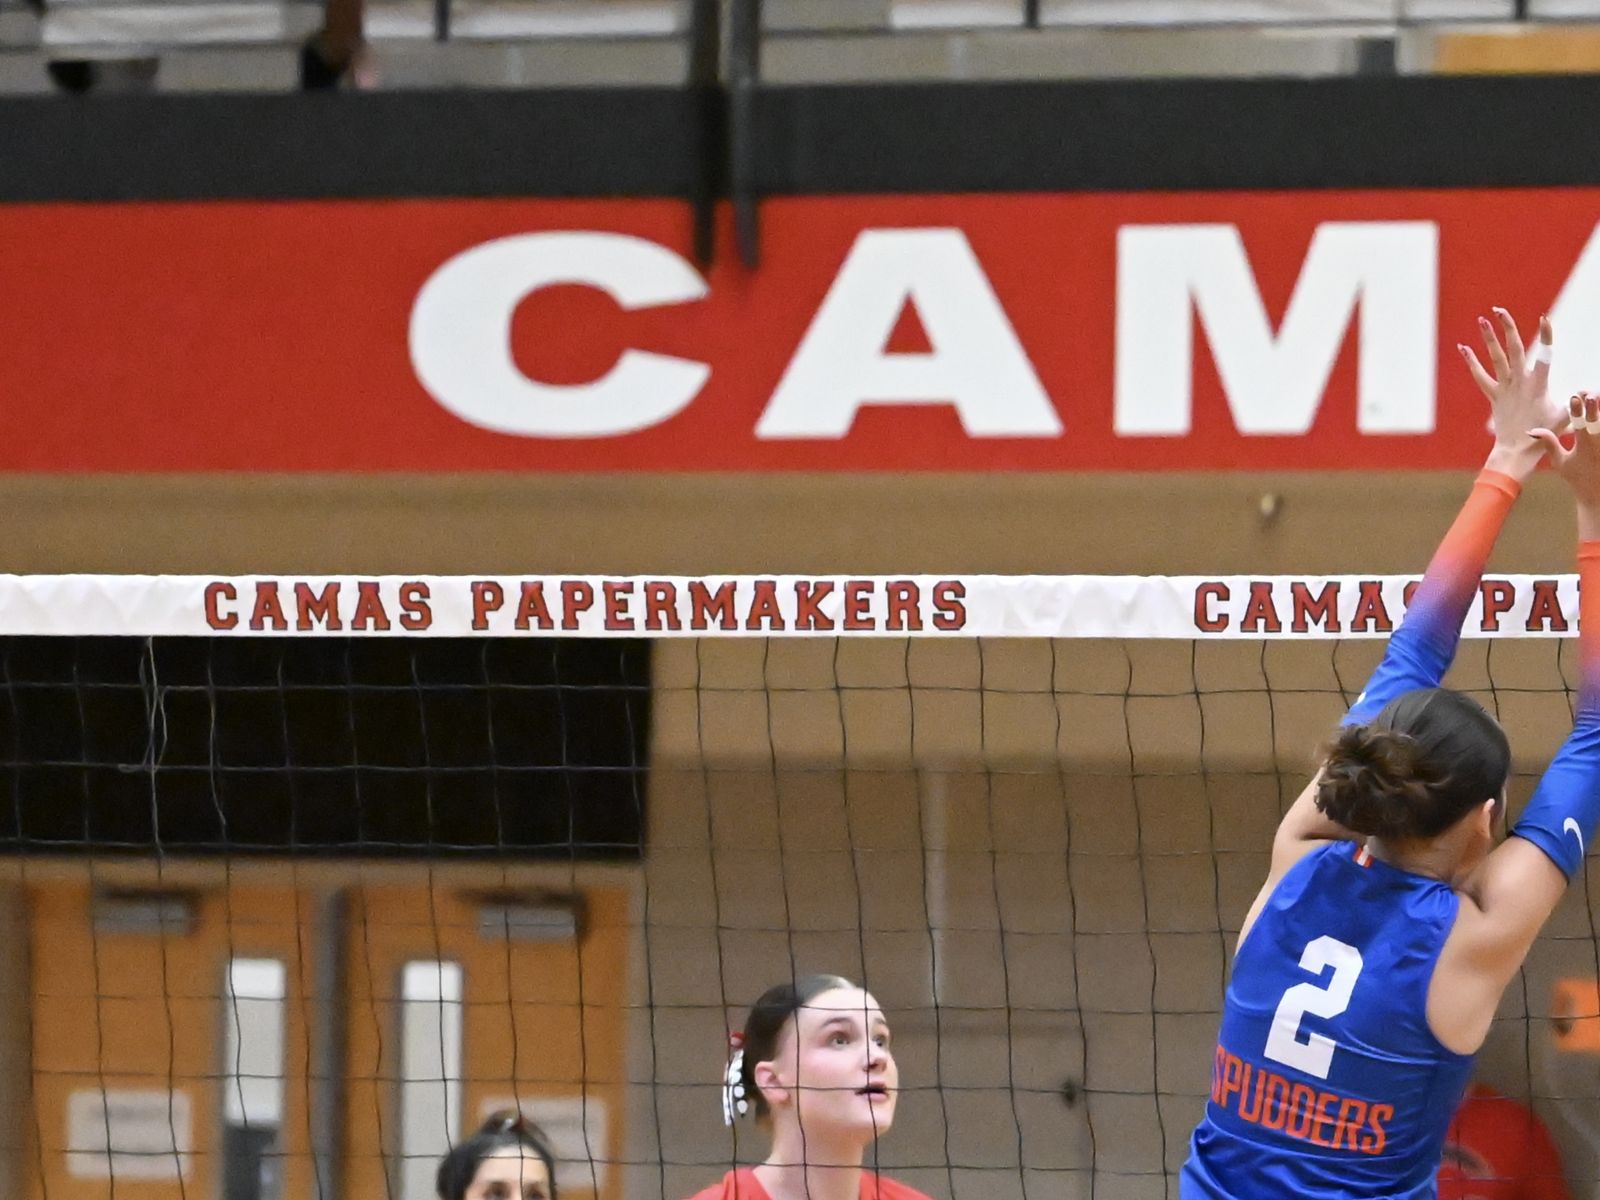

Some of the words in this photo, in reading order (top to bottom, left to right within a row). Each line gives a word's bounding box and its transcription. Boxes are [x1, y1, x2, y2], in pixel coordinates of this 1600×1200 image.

[204, 581, 432, 631] CAMAS
[470, 580, 967, 631] PAPERMAKERS
[1193, 580, 1420, 633] CAMA
[1264, 935, 1363, 1079] 2
[1211, 1044, 1394, 1155] SPUDDERS
